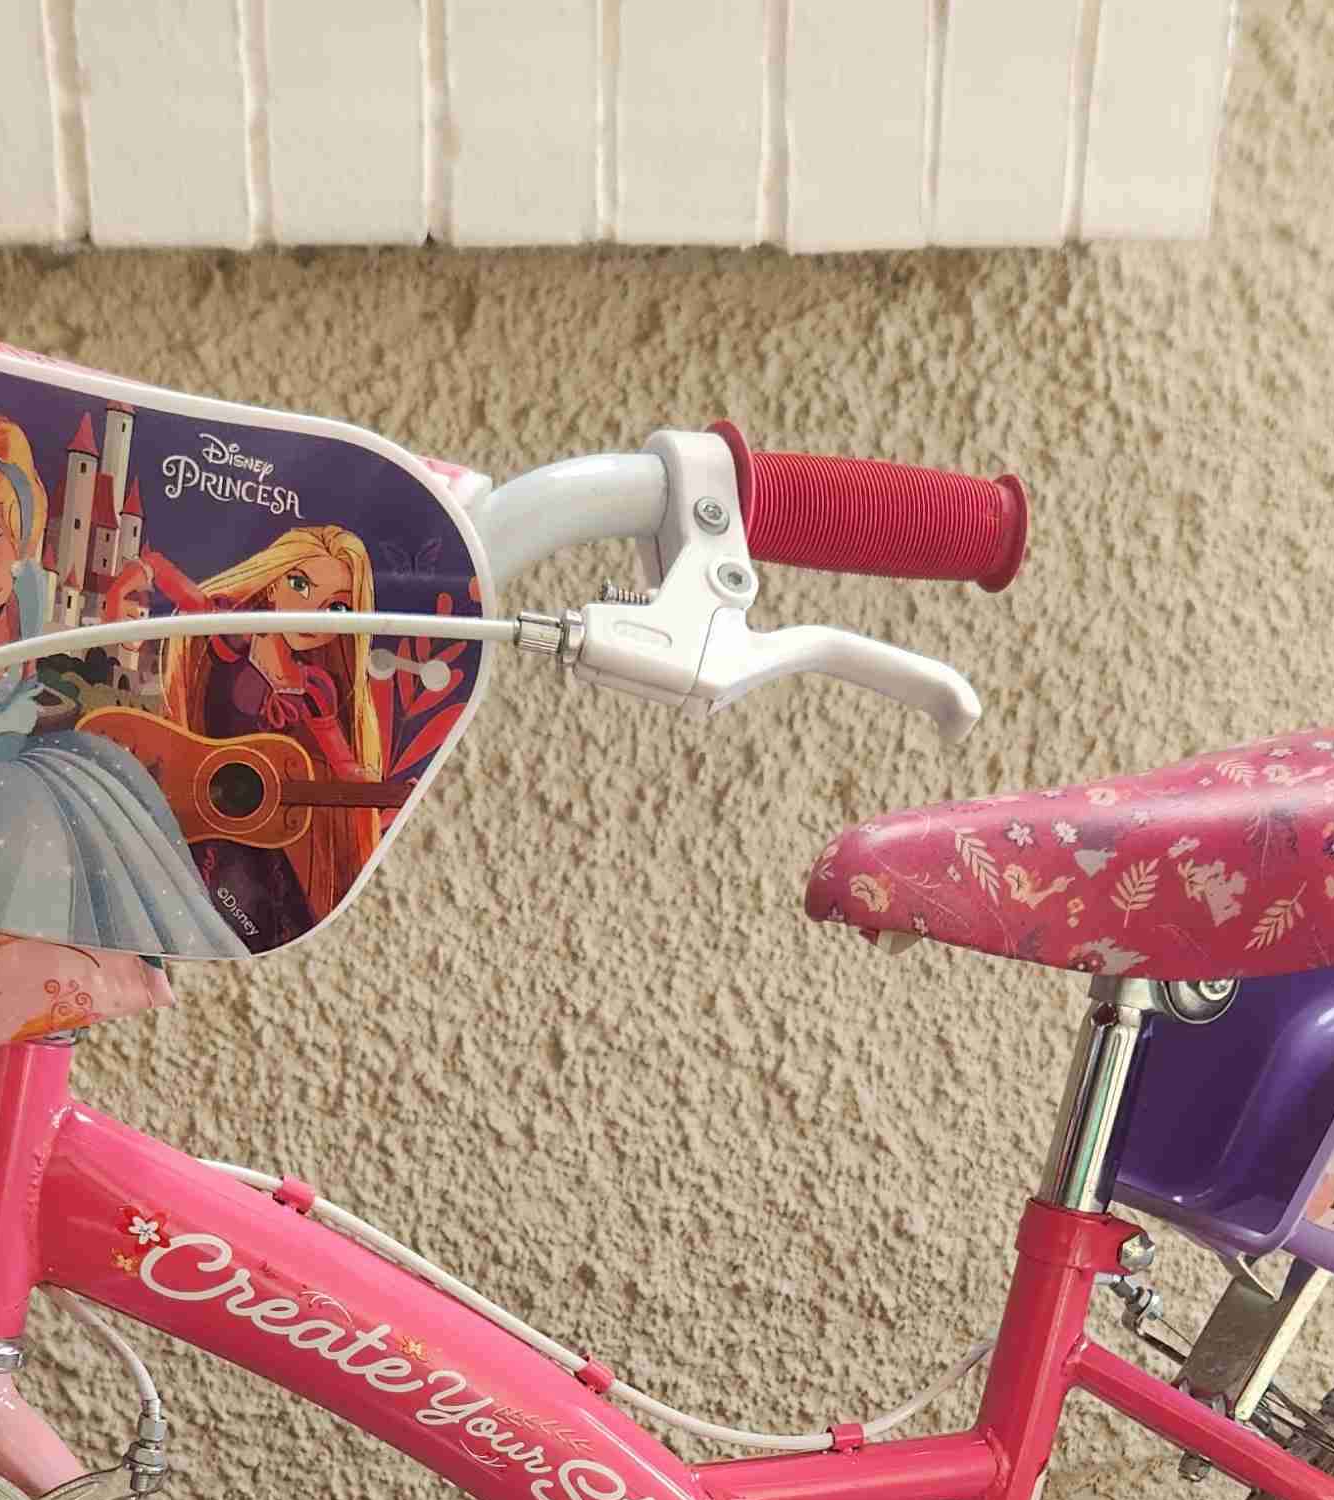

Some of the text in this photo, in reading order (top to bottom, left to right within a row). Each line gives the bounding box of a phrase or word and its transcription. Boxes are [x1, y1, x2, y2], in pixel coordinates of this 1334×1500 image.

[162, 454, 306, 520] PRINCESA
[139, 1232, 424, 1394] Create
[415, 1369, 553, 1476] Your
